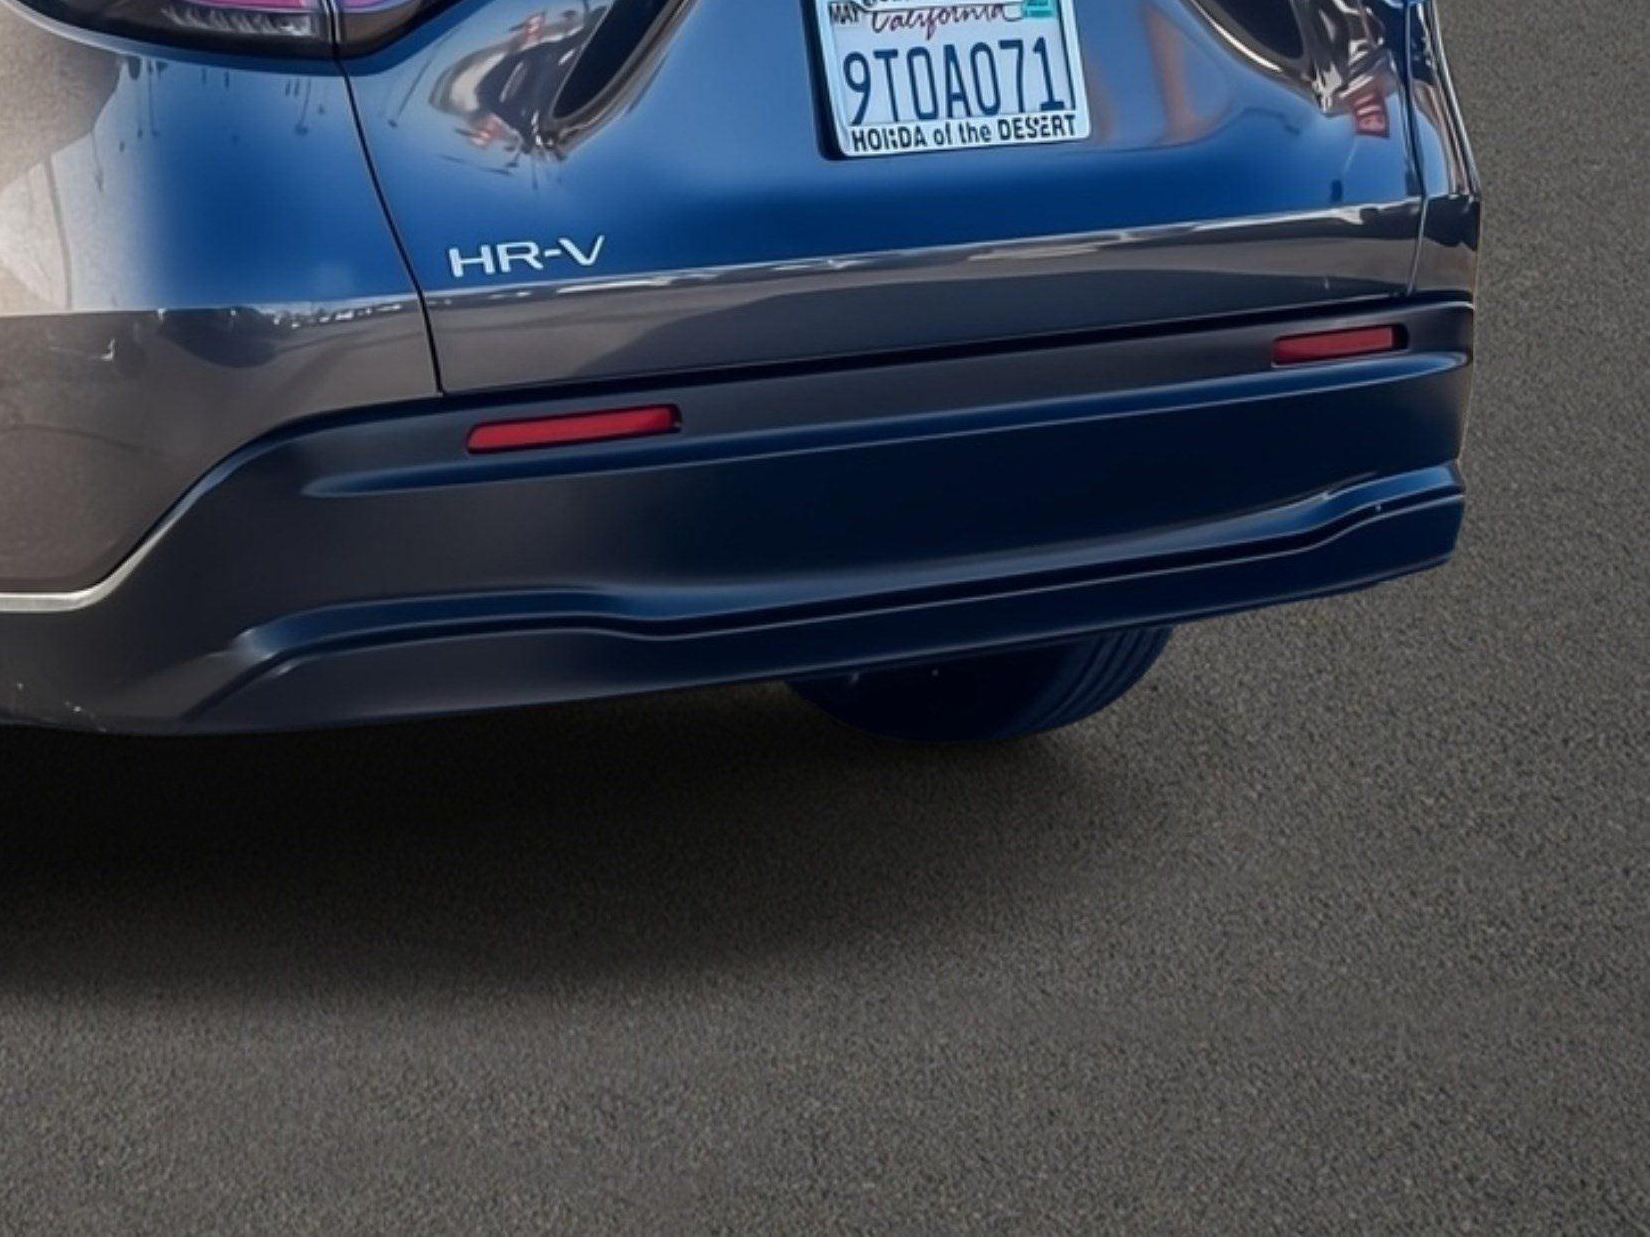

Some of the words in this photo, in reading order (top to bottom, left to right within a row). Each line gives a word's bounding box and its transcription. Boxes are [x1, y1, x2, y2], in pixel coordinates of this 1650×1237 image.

[871, 4, 1006, 40] California
[935, 122, 951, 146] of
[958, 122, 992, 144] the
[998, 114, 1076, 141] DESERT
[448, 235, 605, 278] HR-V
